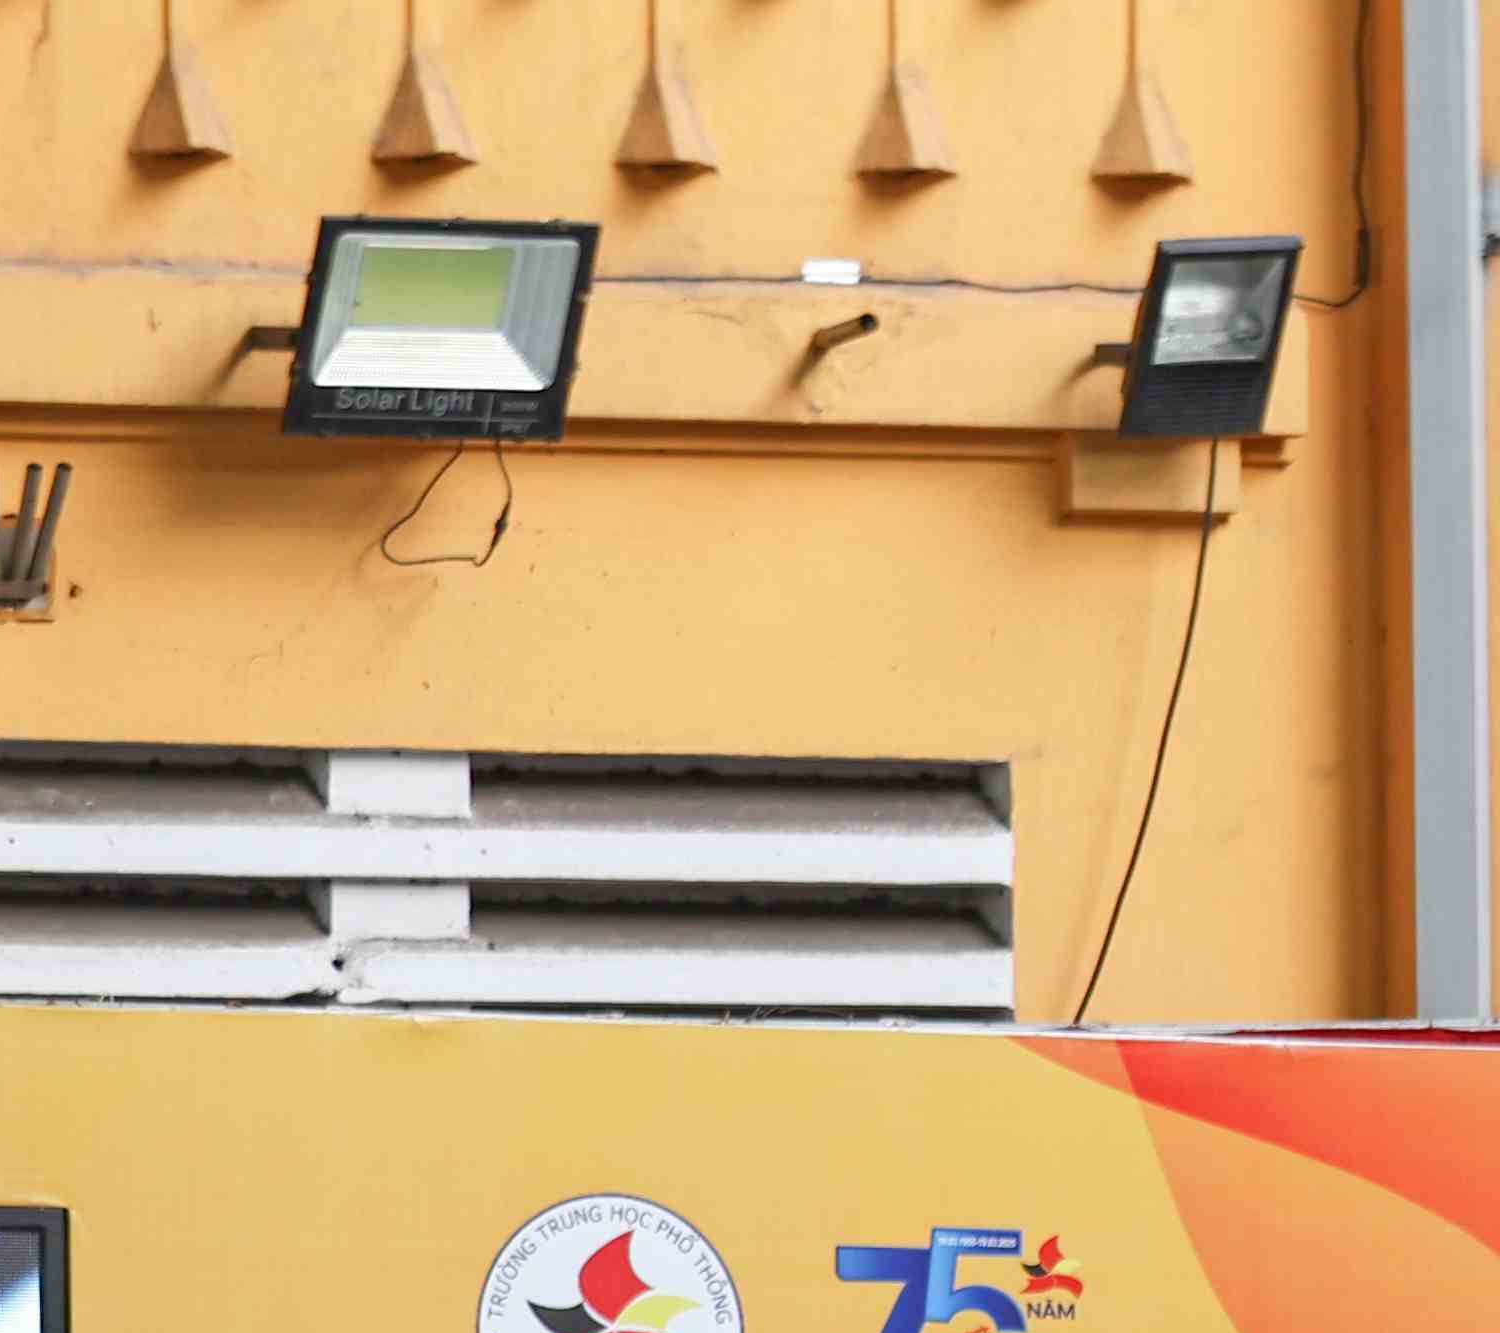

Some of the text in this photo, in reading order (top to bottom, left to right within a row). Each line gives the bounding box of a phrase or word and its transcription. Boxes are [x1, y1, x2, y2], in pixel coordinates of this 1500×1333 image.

[334, 387, 403, 412] Solar
[411, 389, 476, 417] Light
[534, 1205, 603, 1241] TRUNG
[694, 1251, 733, 1325] THÔNG
[1026, 1299, 1076, 1321] NĂM
